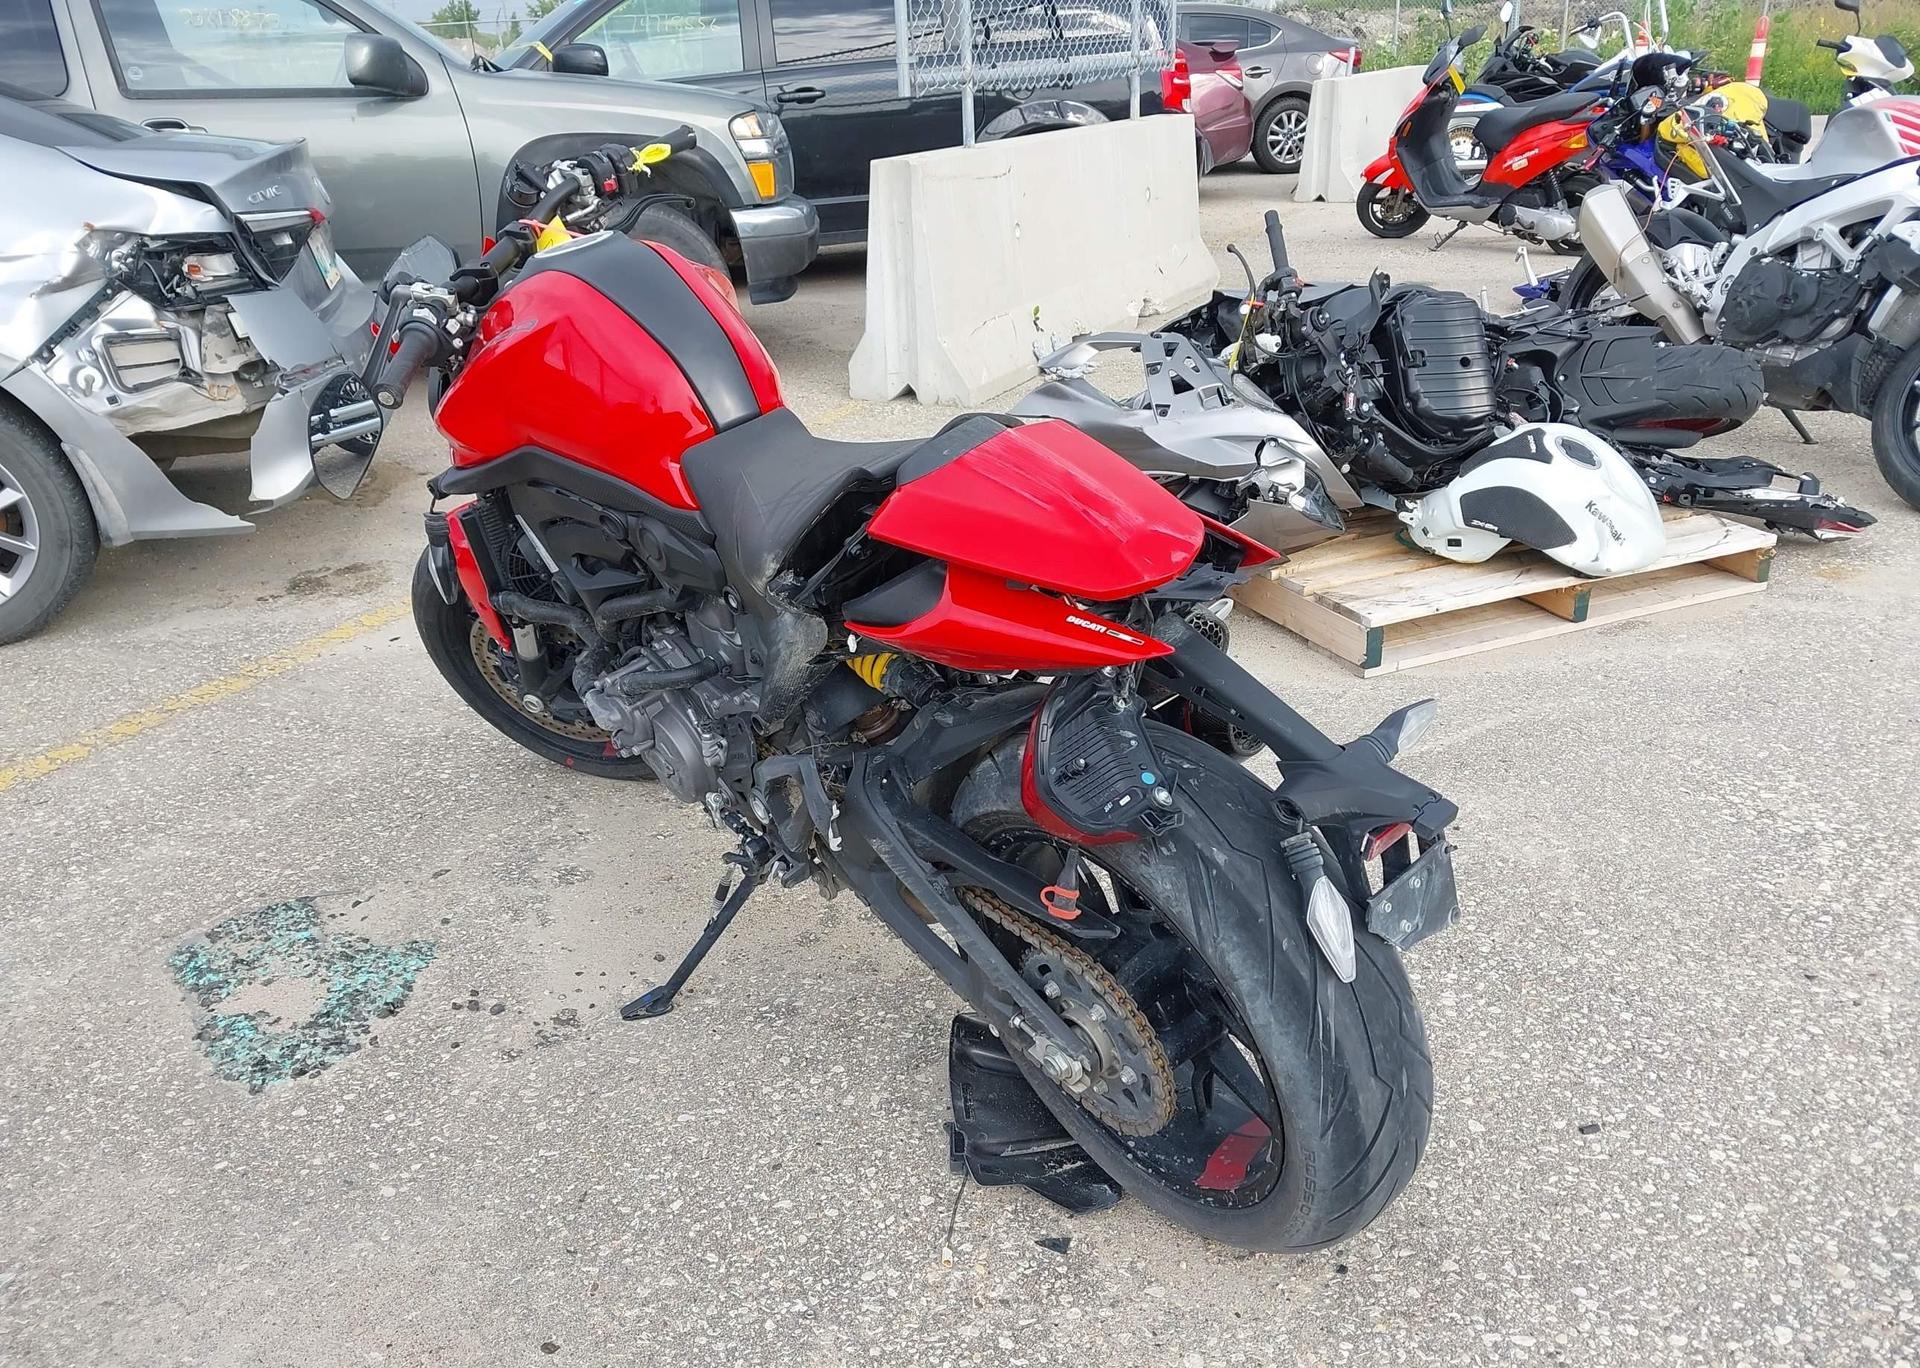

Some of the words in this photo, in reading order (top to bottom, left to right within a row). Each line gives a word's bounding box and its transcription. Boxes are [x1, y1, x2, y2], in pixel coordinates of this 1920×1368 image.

[247, 185, 282, 204] CIVIC
[1584, 500, 1626, 547] Kawasaki
[1066, 615, 1107, 633] DUCATI
